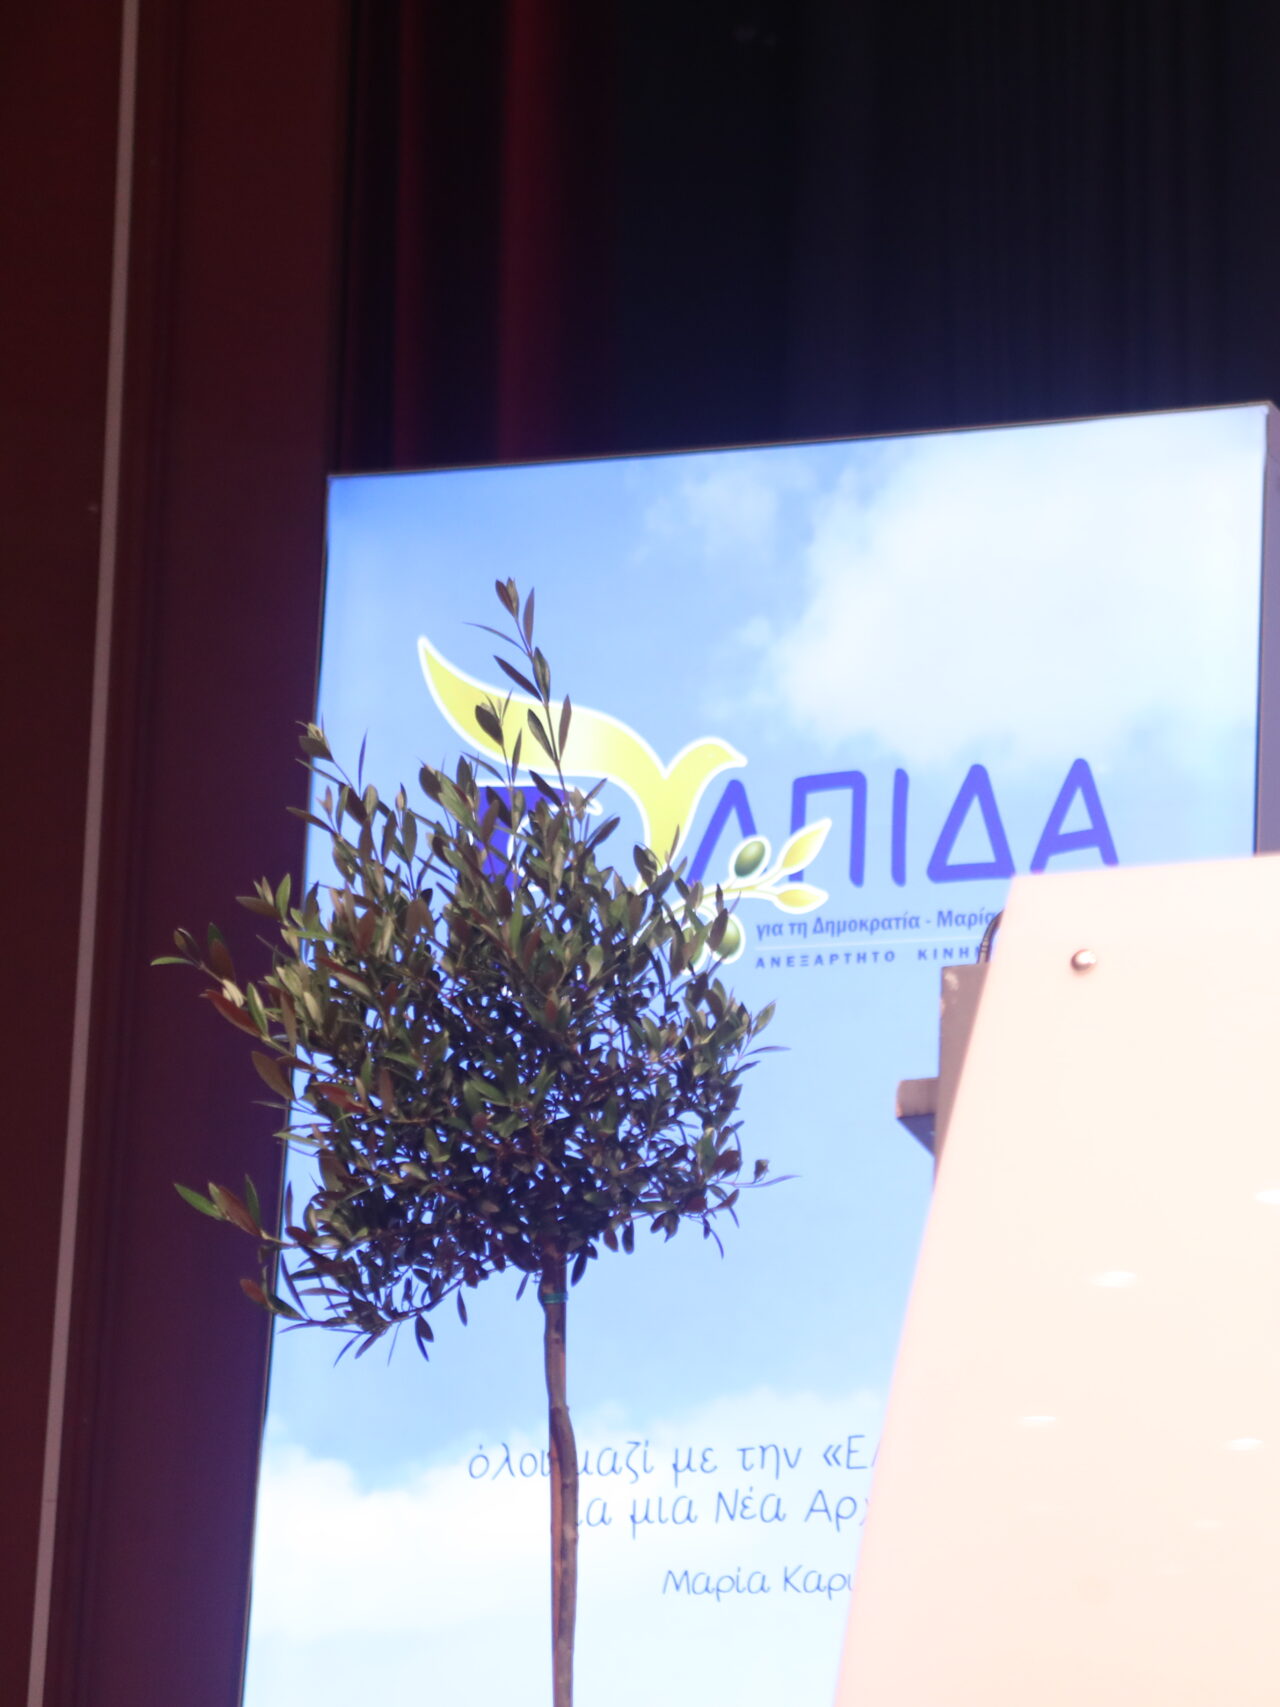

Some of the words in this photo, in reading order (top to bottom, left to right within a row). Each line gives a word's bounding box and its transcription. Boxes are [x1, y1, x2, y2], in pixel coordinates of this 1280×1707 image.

[755, 921, 783, 942] για
[787, 920, 808, 939] τη
[812, 911, 921, 938] Δημοκρατία
[755, 950, 896, 969] ΑΝΕΞΑΡΤΗΤΟ
[917, 945, 980, 961] ΚΙΝΗ
[672, 1447, 719, 1488] με
[736, 1443, 803, 1481] την
[629, 1495, 699, 1541] μια
[714, 1485, 787, 1524] Νέα
[661, 1566, 771, 1602] Μαρία
